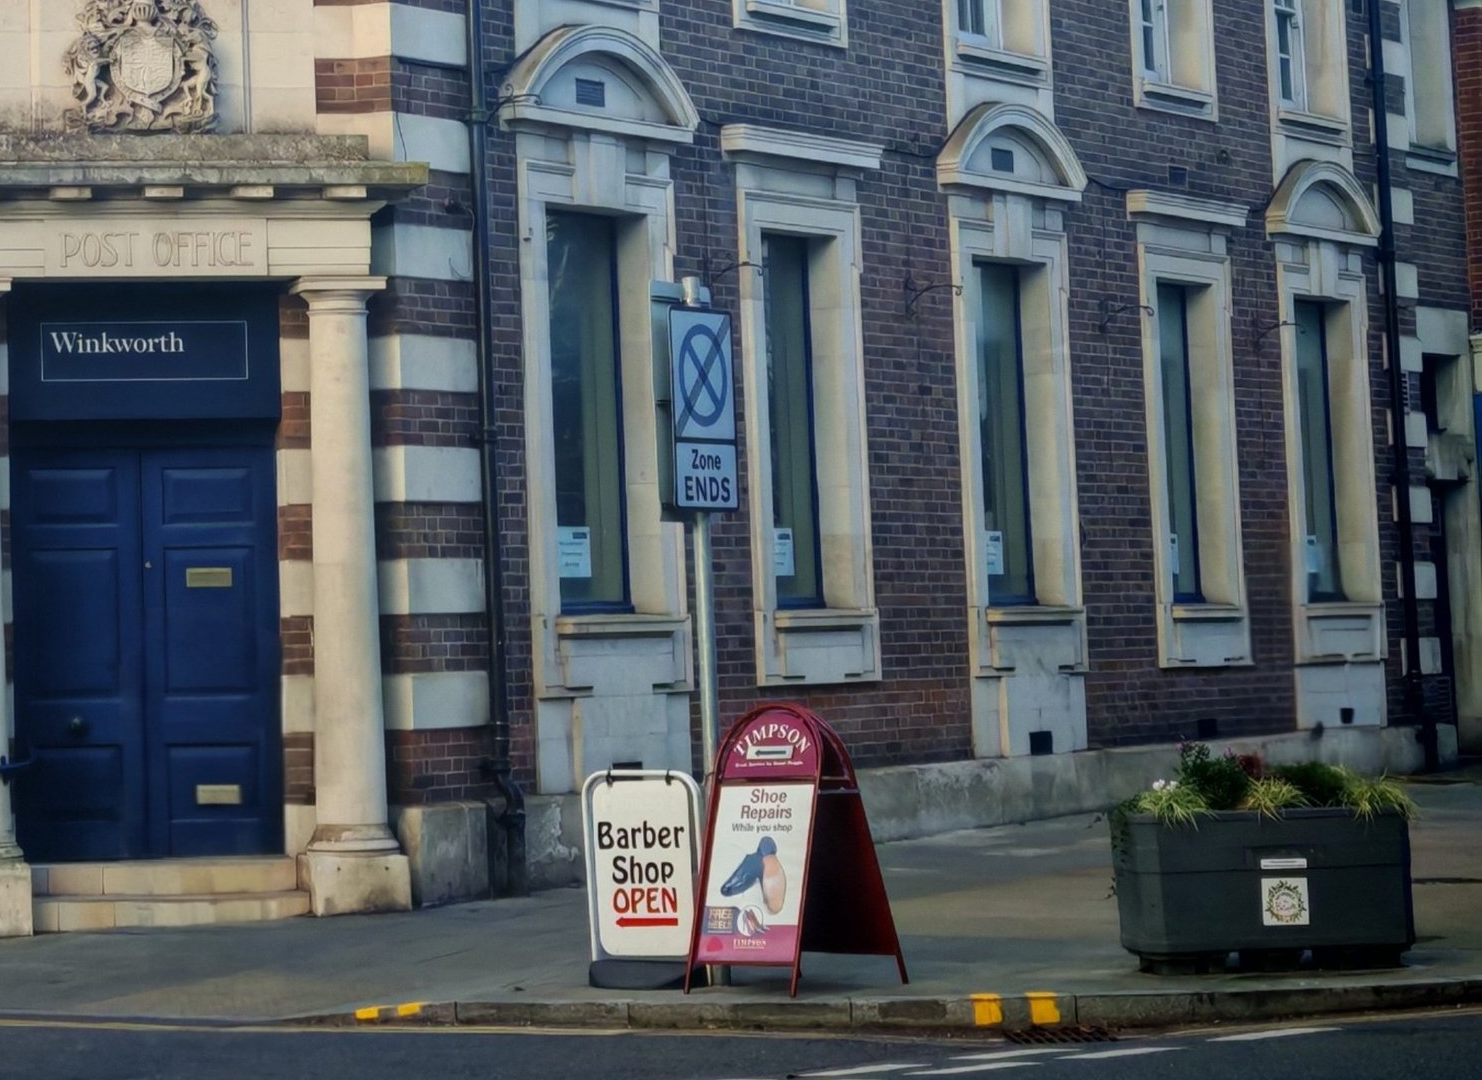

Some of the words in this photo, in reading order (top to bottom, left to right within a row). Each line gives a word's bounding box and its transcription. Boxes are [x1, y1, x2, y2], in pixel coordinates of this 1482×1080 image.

[60, 233, 139, 267] POST
[152, 232, 254, 267] OFFICE
[50, 332, 184, 354] Winkworth
[691, 449, 721, 470] Zone
[685, 476, 731, 503] ENDS
[733, 723, 811, 756] TIMPSON
[750, 788, 787, 804] Shoe
[740, 805, 792, 822] Repairs
[598, 820, 685, 850] Barber
[731, 823, 754, 832] While
[756, 825, 771, 833] you
[773, 823, 793, 833] shop
[612, 855, 674, 884] Shop
[613, 887, 678, 914] OPEN
